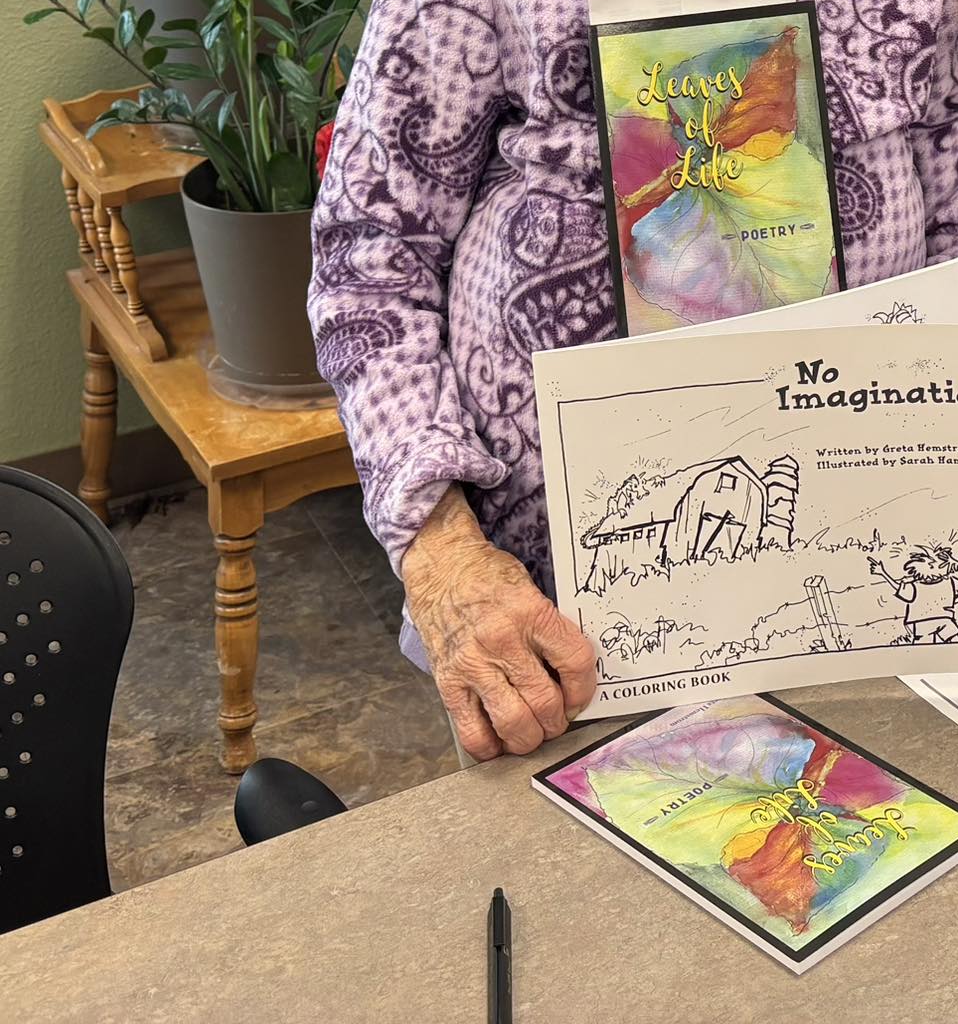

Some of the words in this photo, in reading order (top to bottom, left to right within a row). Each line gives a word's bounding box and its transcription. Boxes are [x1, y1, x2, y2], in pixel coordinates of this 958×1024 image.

[637, 61, 744, 105] Leaves
[685, 99, 716, 147] of
[670, 142, 744, 191] Life
[741, 222, 796, 242] POETRY
[794, 359, 840, 385] No
[816, 447, 862, 458] Written
[865, 445, 879, 456] by
[882, 444, 914, 455] Greta
[816, 458, 879, 470] Illustrated
[883, 458, 897, 468] by
[900, 456, 935, 466] Sarah
[599, 690, 609, 702] A
[613, 678, 687, 699] COLORING
[691, 671, 731, 688] BOOK
[660, 781, 713, 817] POETRY
[750, 778, 823, 824] Life
[795, 811, 840, 844] of
[802, 808, 918, 876] Leaves
